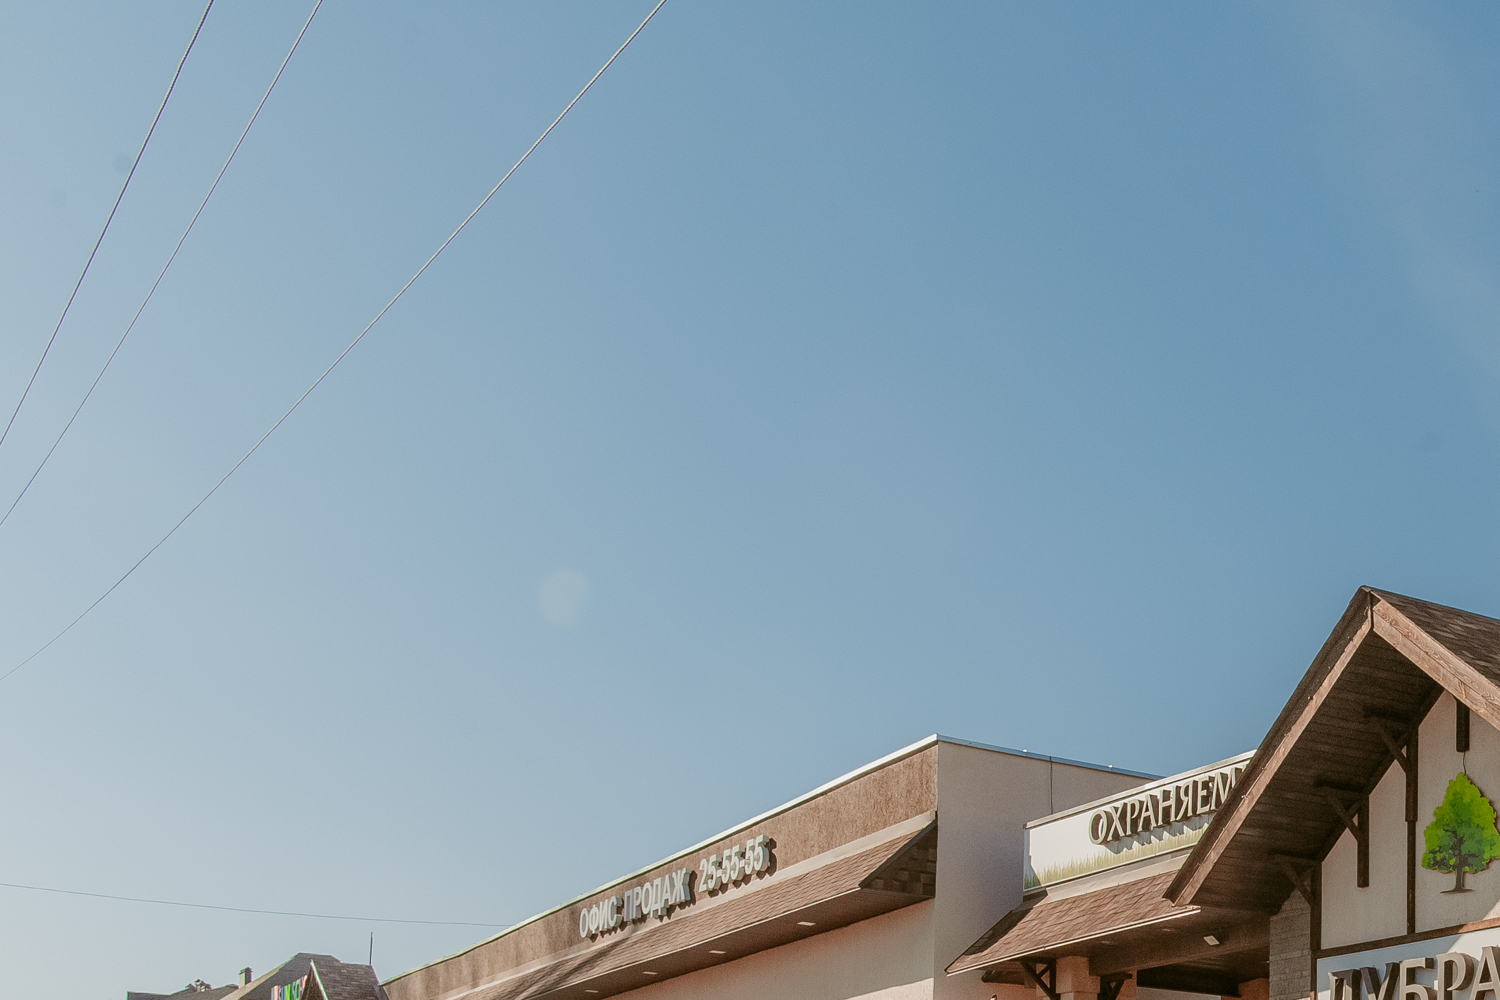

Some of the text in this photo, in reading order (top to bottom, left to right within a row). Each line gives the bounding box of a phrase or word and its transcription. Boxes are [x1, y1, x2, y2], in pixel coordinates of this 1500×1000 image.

[1089, 764, 1248, 845] ОХРАНЯЕМ
[580, 834, 770, 938] ОФИС ПРОДАЖ 25-55-55
